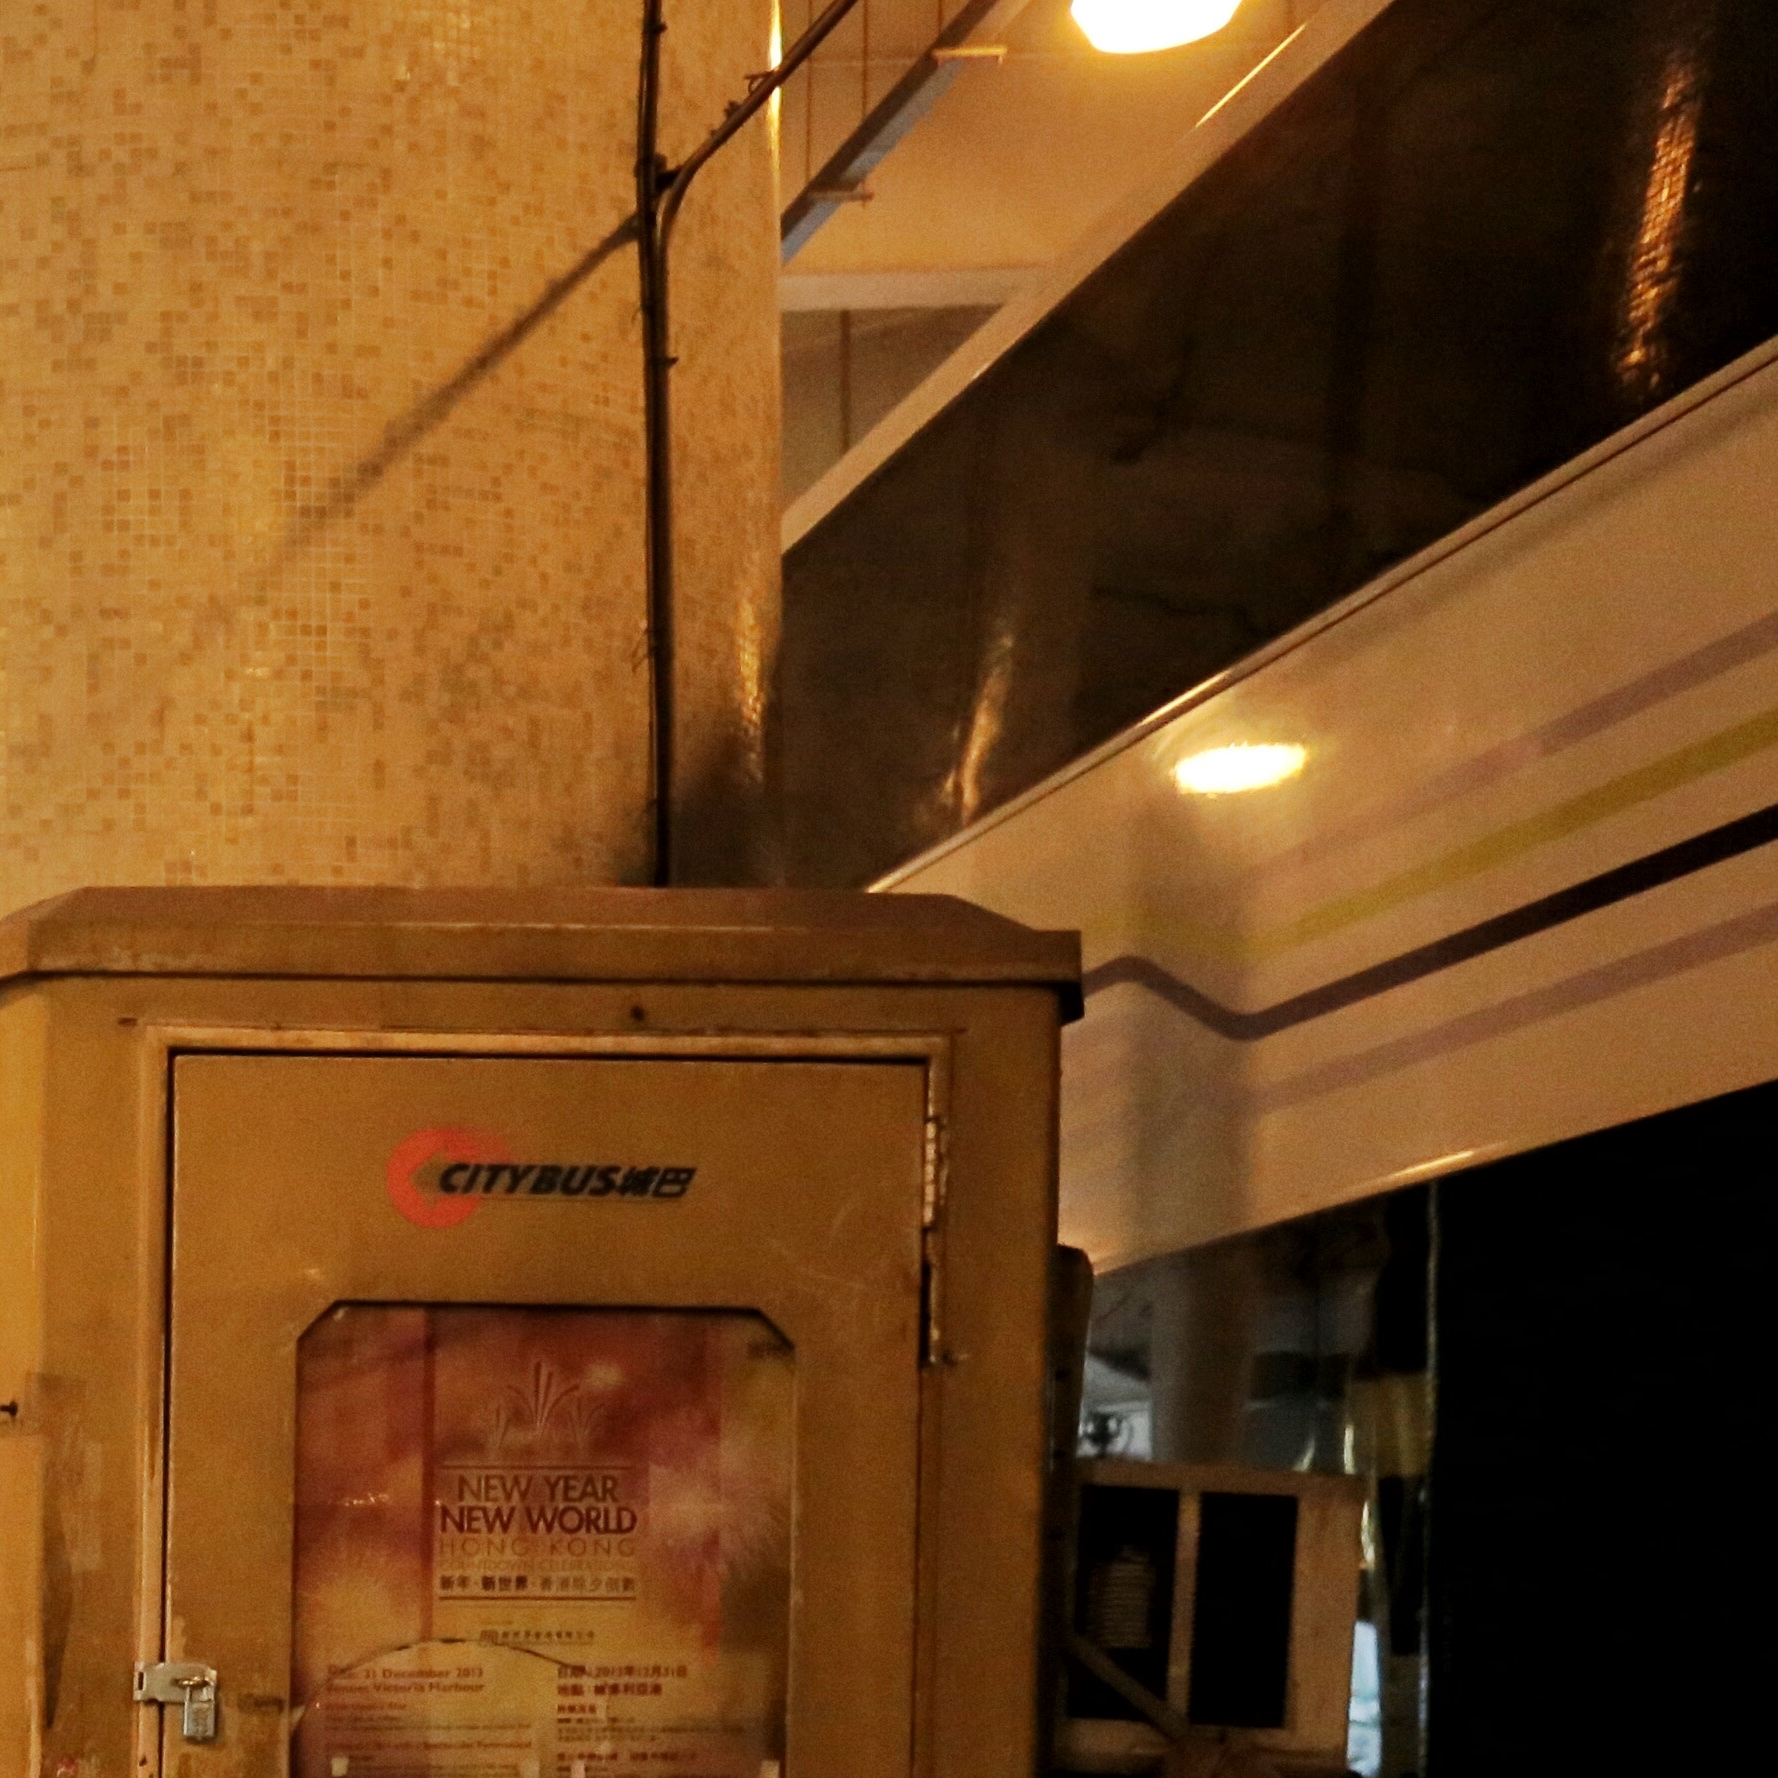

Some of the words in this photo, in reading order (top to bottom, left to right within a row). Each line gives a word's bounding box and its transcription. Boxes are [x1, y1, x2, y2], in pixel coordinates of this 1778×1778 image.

[439, 1162, 620, 1197] CITYBUS
[458, 1475, 533, 1502] NEW
[544, 1475, 619, 1502] YEAR
[440, 1506, 516, 1534] NEW
[526, 1506, 637, 1534] WORLD
[440, 1538, 530, 1557] HONG
[549, 1538, 635, 1557] KONG
